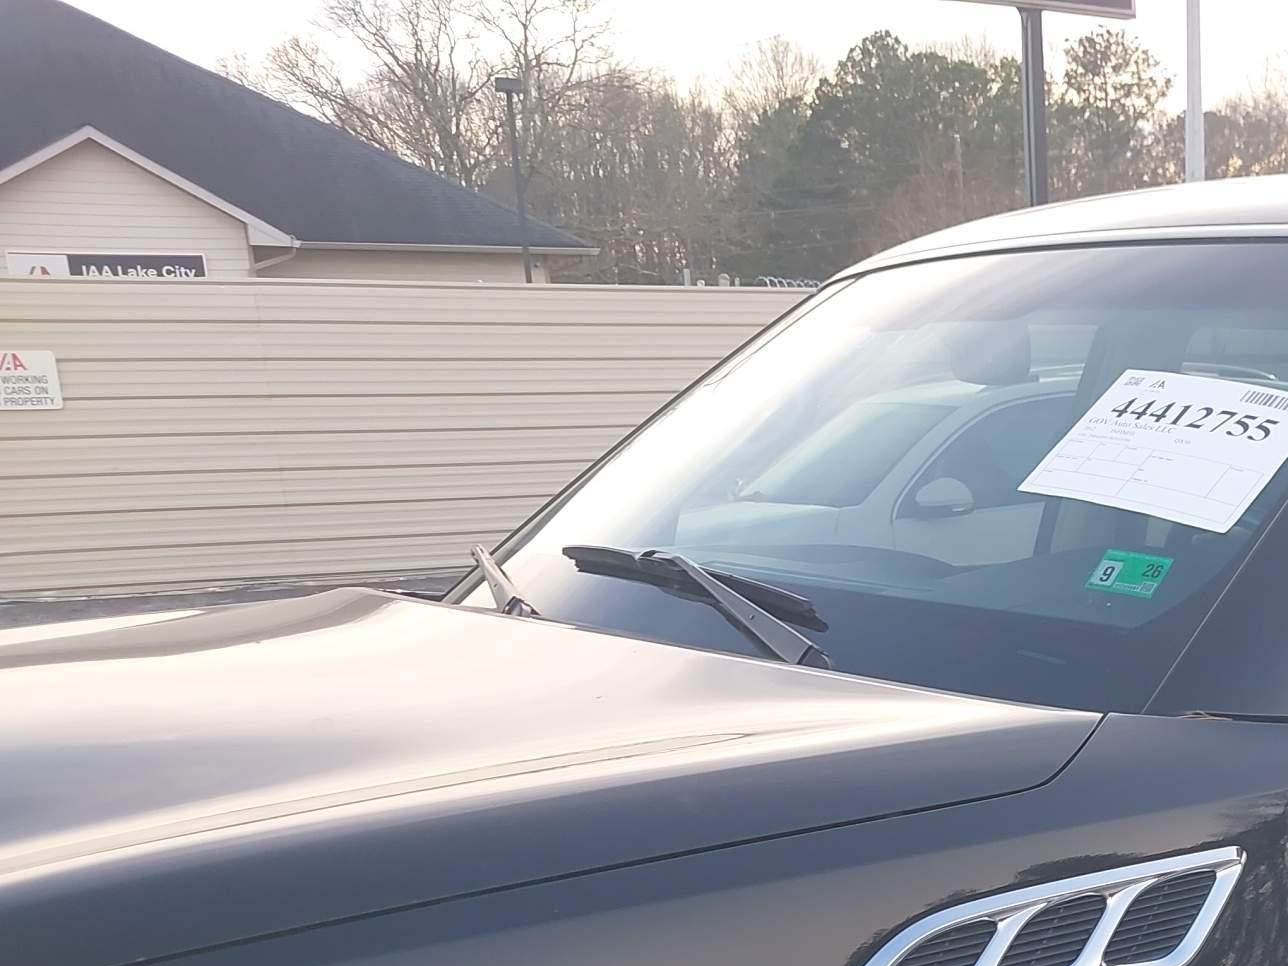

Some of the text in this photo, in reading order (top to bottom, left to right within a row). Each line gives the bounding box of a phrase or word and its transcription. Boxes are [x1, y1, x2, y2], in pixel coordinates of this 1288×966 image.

[81, 264, 197, 278] IAA Lake City
[1, 375, 48, 385] WORKING
[3, 386, 31, 395] CARS
[34, 386, 48, 395] ON
[3, 397, 55, 406] PROPERTY
[1110, 396, 1281, 442] 44412755
[1132, 421, 1155, 433] Sales
[1099, 563, 1164, 583] 9 26
